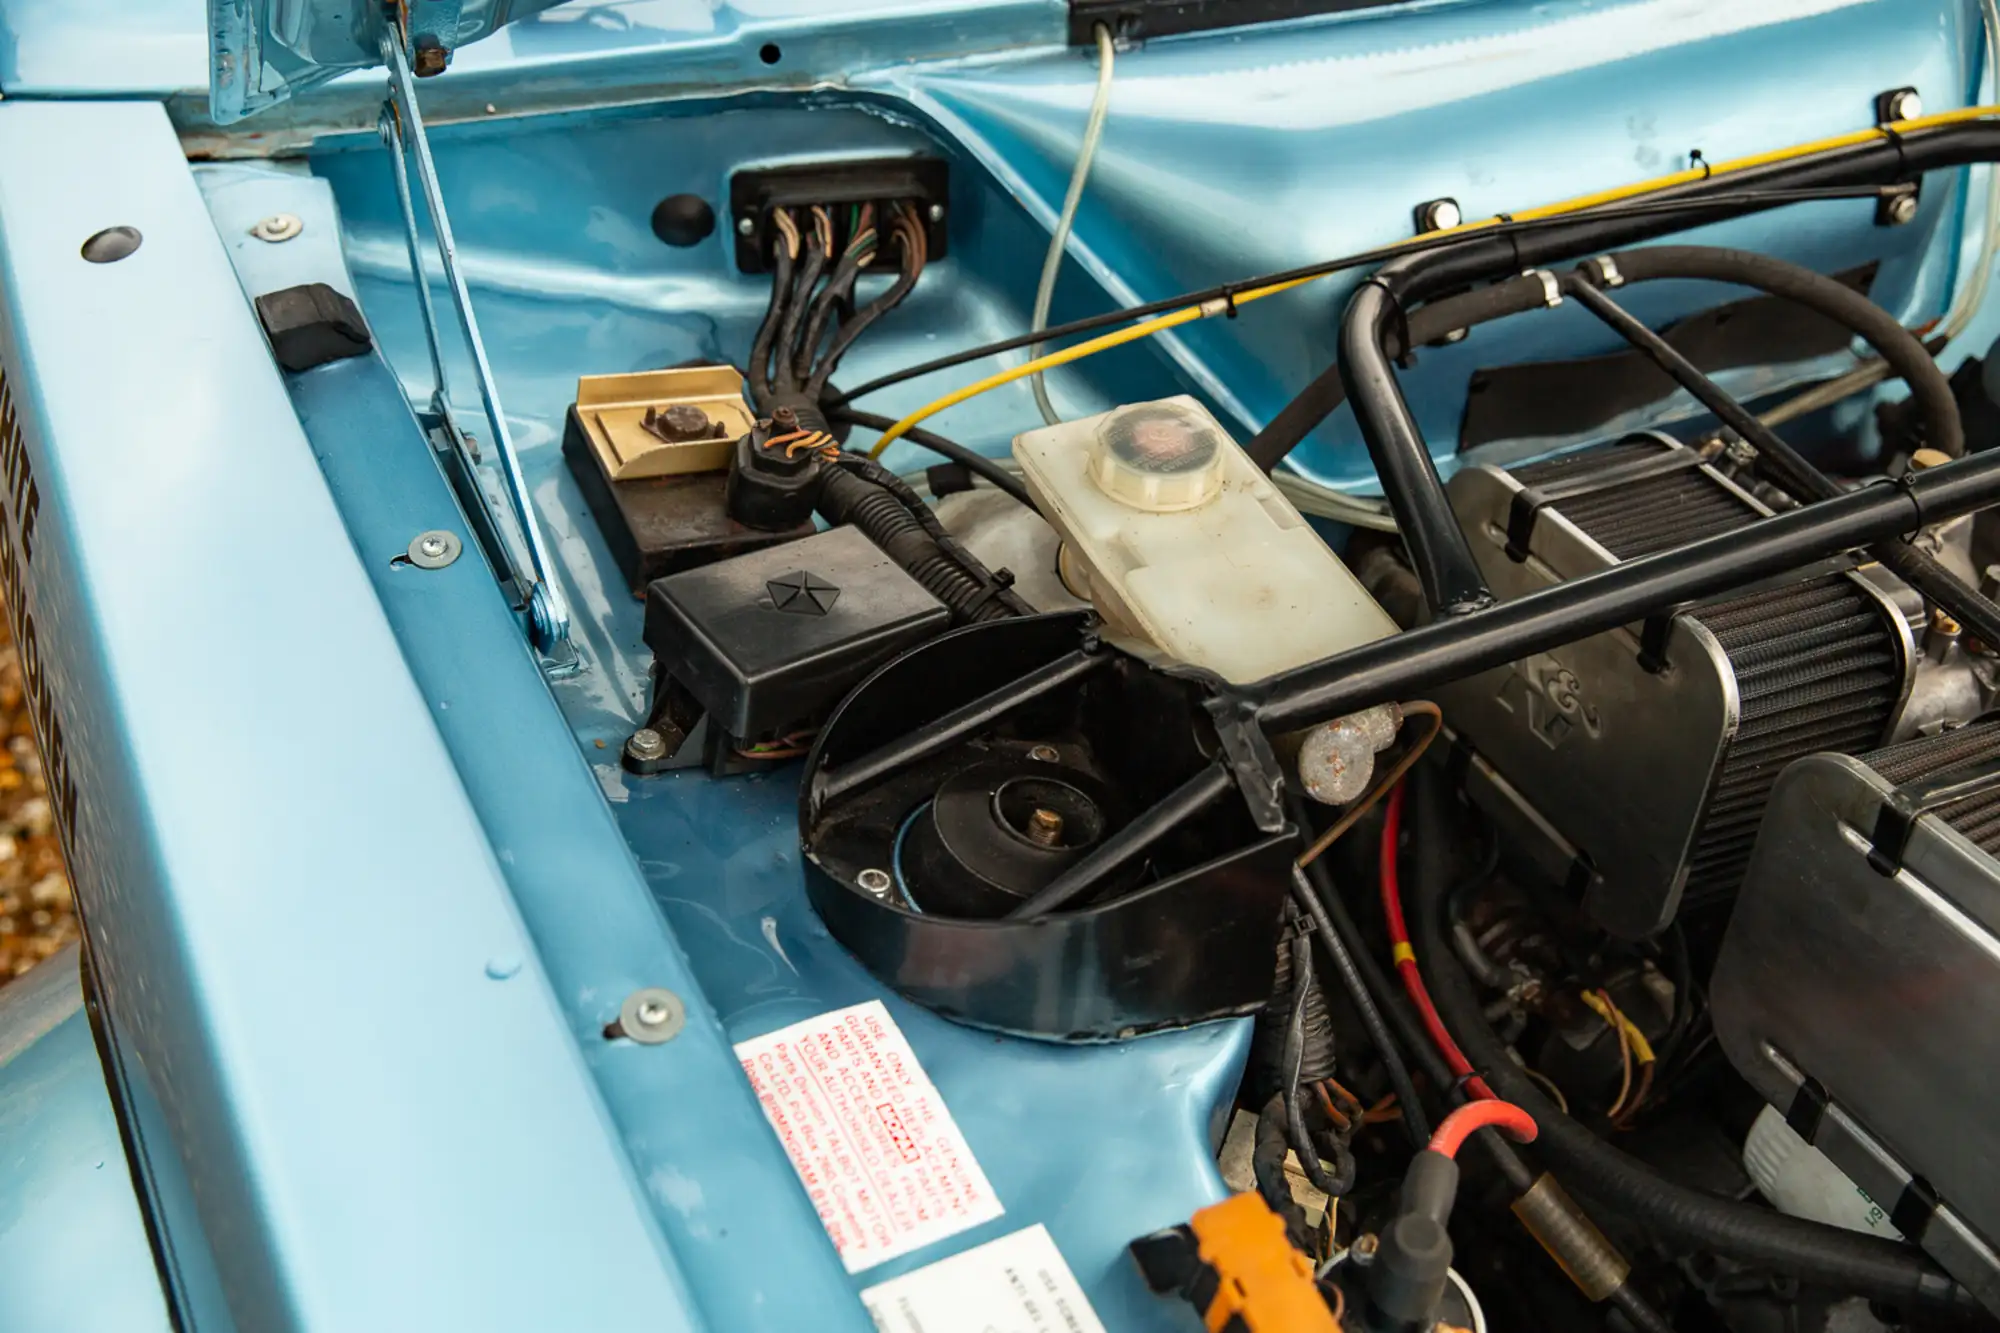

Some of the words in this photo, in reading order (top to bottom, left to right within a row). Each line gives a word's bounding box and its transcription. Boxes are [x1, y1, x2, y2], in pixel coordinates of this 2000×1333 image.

[800, 1034, 827, 1071] YOUR
[875, 1170, 913, 1230] DEALER
[817, 1032, 840, 1059] AND
[838, 1067, 899, 1167] ACCESSORIES
[900, 1176, 929, 1221] FROM
[826, 1129, 860, 1182] TALBOT
[857, 1188, 891, 1246] MOTOR
[833, 1024, 864, 1067] PARTS
[859, 1071, 882, 1099] AND
[915, 1167, 944, 1217] PARTS
[845, 1015, 904, 1102] GUARANTEED
[901, 1107, 966, 1214] REPLACEMENT
[864, 1015, 886, 1040] USE
[886, 1052, 912, 1084] ONLY
[915, 1096, 934, 1123] THE
[936, 1137, 977, 1201] GENUINE
